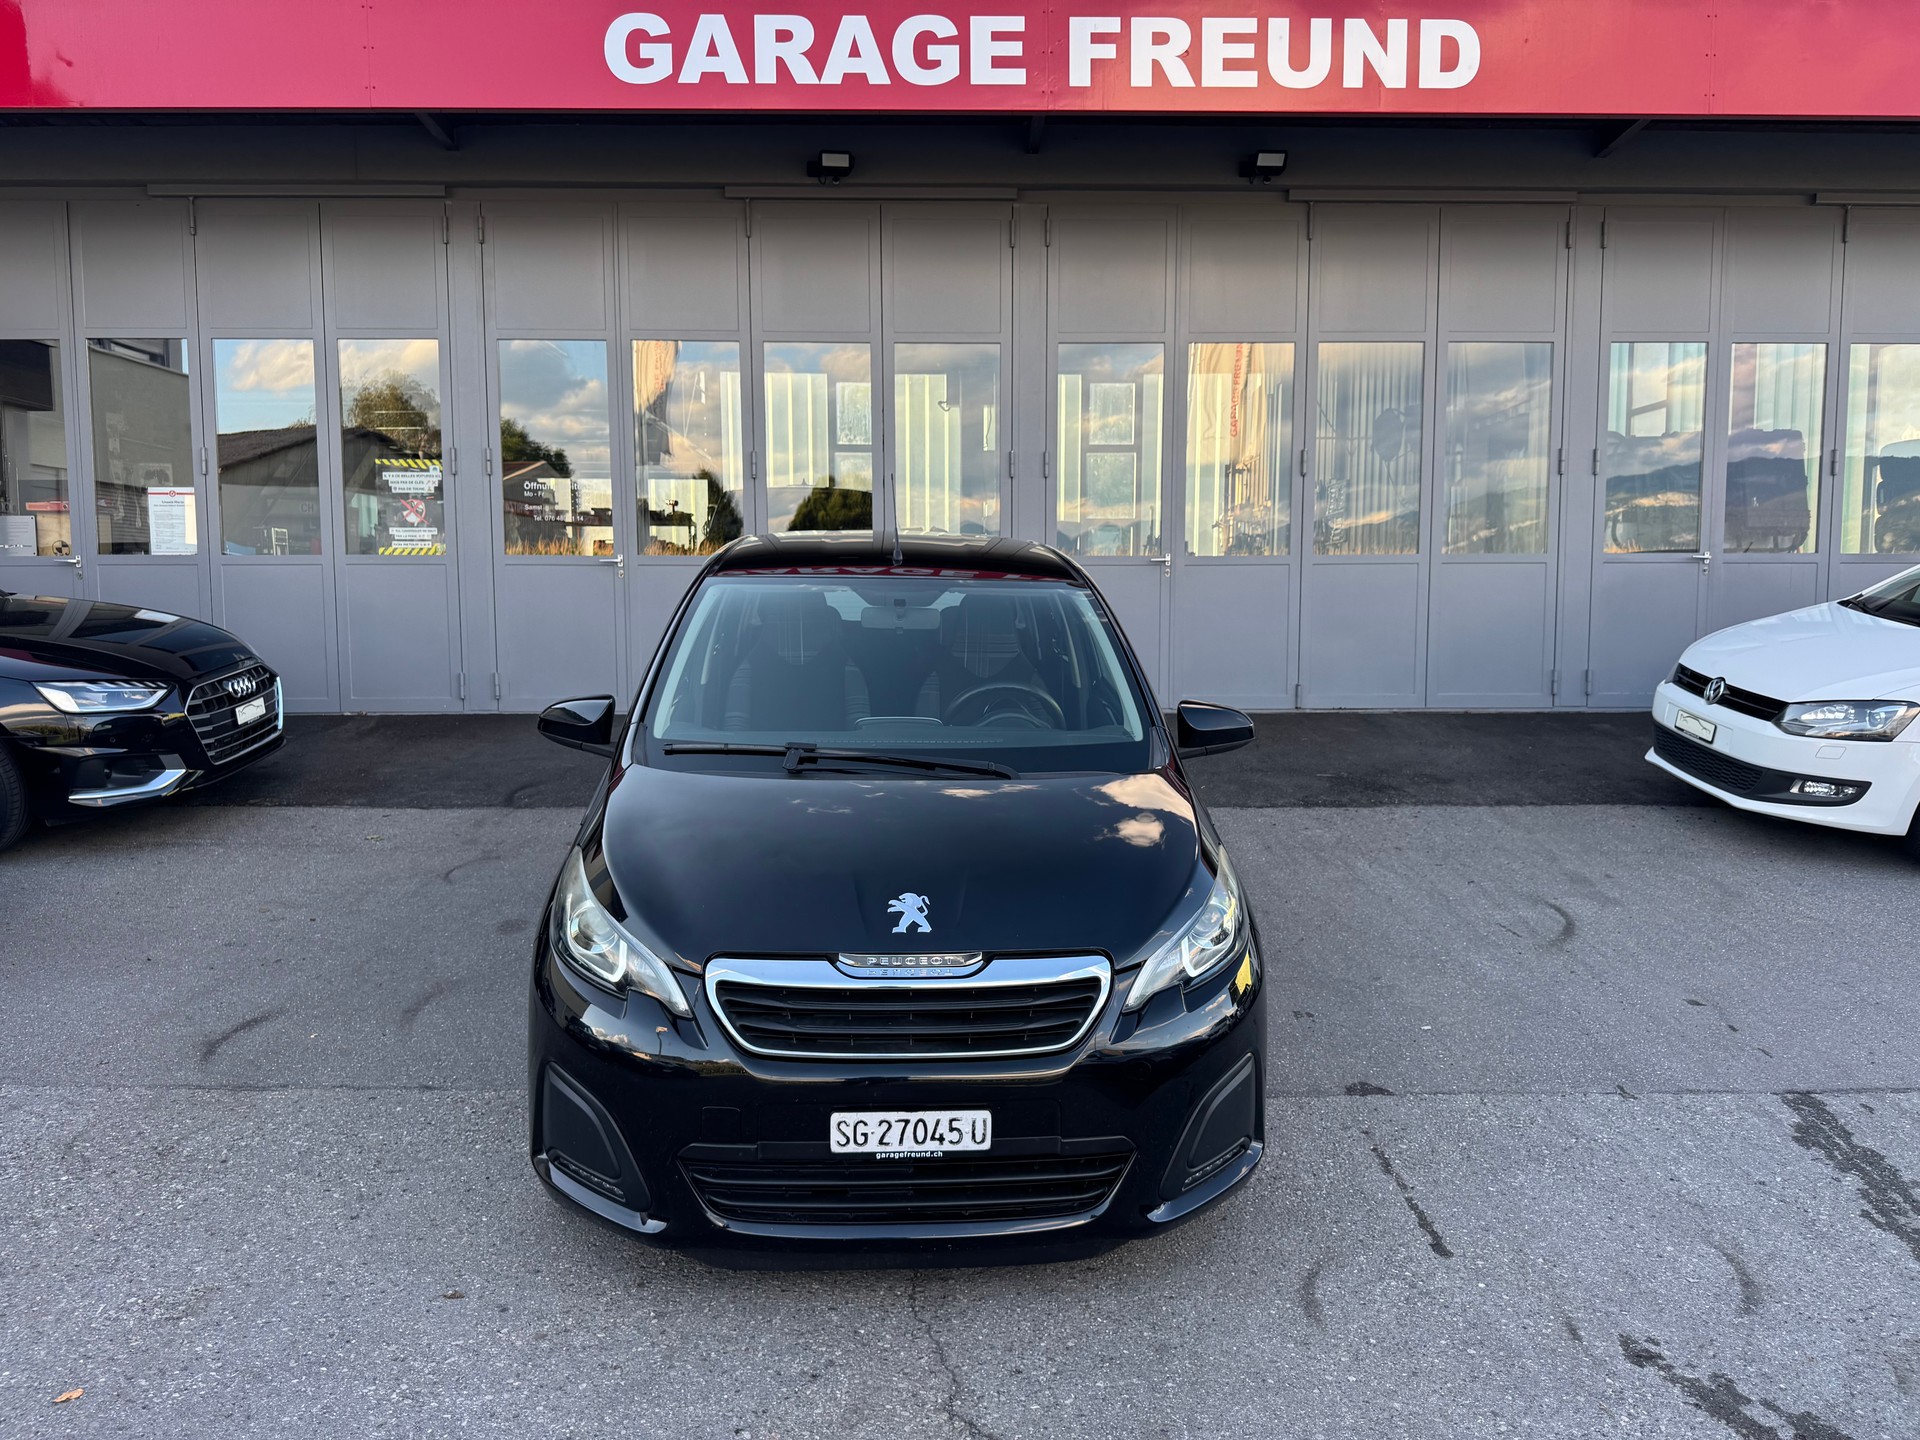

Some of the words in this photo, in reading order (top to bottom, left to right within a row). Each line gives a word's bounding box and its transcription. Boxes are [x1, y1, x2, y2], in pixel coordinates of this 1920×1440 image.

[604, 12, 1026, 85] GARAGE
[1069, 16, 1481, 89] FREUND
[867, 956, 954, 966] PEUGEOT
[876, 1151, 943, 1159] garagefreund.ch
